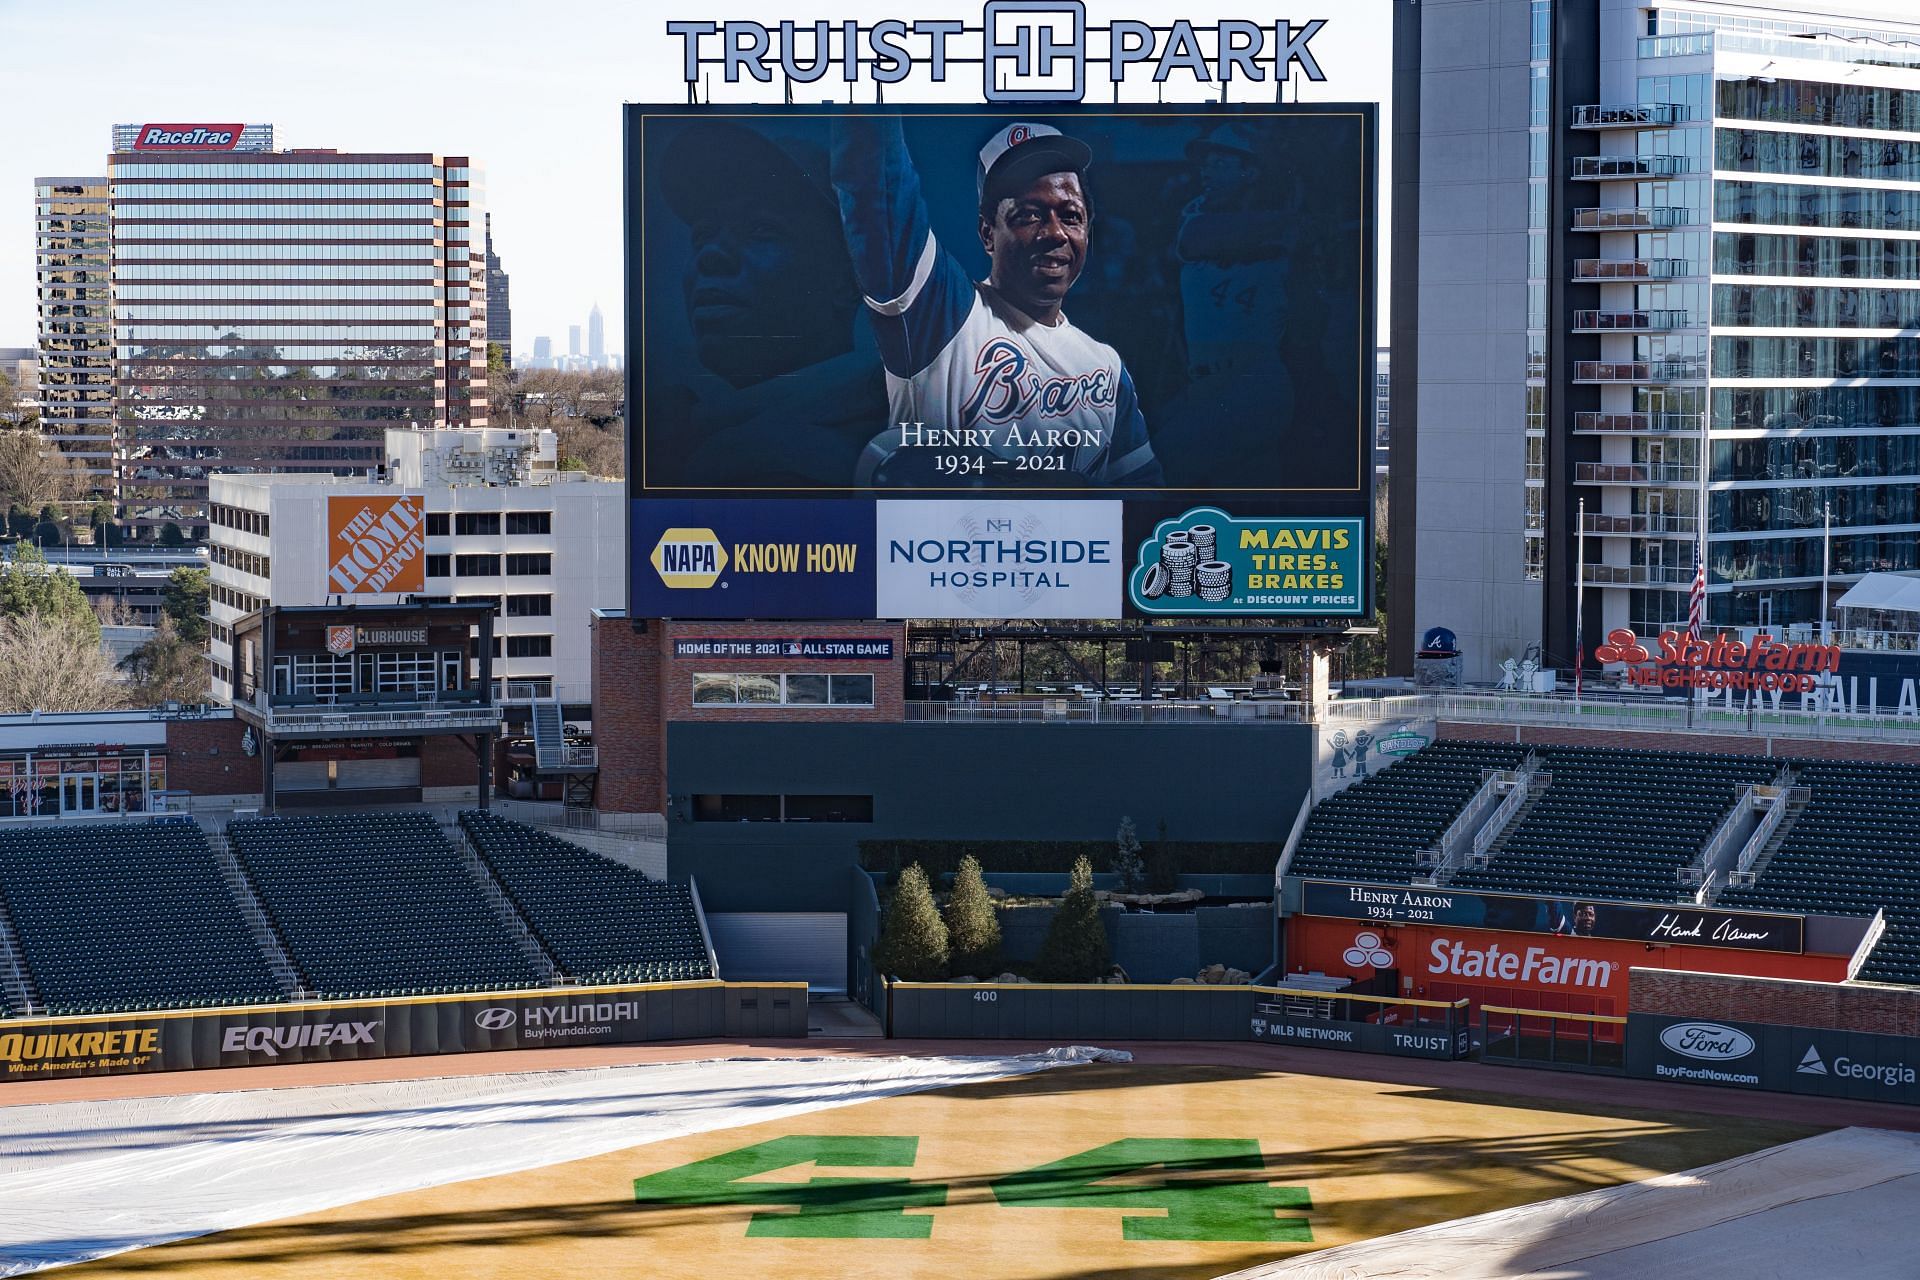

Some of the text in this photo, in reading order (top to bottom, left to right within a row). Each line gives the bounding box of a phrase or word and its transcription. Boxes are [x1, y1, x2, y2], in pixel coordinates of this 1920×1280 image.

[667, 19, 1328, 83] TRUIST PARK
[143, 128, 232, 144] RaceTrac
[960, 337, 1116, 428] Braves
[936, 455, 986, 475] 1934
[1016, 455, 1066, 471] 2021
[337, 506, 378, 545] THE
[329, 495, 424, 593] HOME
[1239, 528, 1349, 550] MAVIS
[366, 531, 424, 593] DEPOT
[663, 543, 857, 573] NAPA KNOW HOW
[890, 540, 1110, 563] NORTHSIDE
[1252, 554, 1339, 571] TIRES &
[930, 572, 1070, 587] HOSPITAL
[1248, 574, 1344, 589] BRAKES
[1247, 595, 1309, 604] DISCOUNT
[1312, 595, 1355, 604] PRICES
[357, 629, 425, 644] CLUBHOUSE
[678, 643, 710, 654] HOME
[713, 643, 728, 654] OF
[729, 643, 751, 654] THE
[755, 643, 780, 654] 2021
[857, 643, 889, 655] GAME
[1627, 667, 1815, 693] NEIGHBORHOOD
[1367, 906, 1393, 918] 1934
[1407, 909, 1434, 920] 2021
[1650, 914, 1704, 936] Hank
[973, 991, 997, 1001] 400
[524, 1001, 638, 1026] HYUNDAI
[221, 1021, 379, 1056] EQUIFAX
[524, 1025, 612, 1039] BuyHyundai.com
[1270, 1024, 1353, 1042] MLB NETWORK
[1393, 1034, 1449, 1051] TRUIST
[1679, 1027, 1735, 1054] Ford
[0, 1028, 158, 1062] QUIKRETE
[9, 1064, 38, 1072] What
[41, 1060, 96, 1071] America's
[99, 1057, 130, 1067] Made
[1656, 1065, 1758, 1084] BuyFordNow.com
[1834, 1057, 1915, 1086] Georgia
